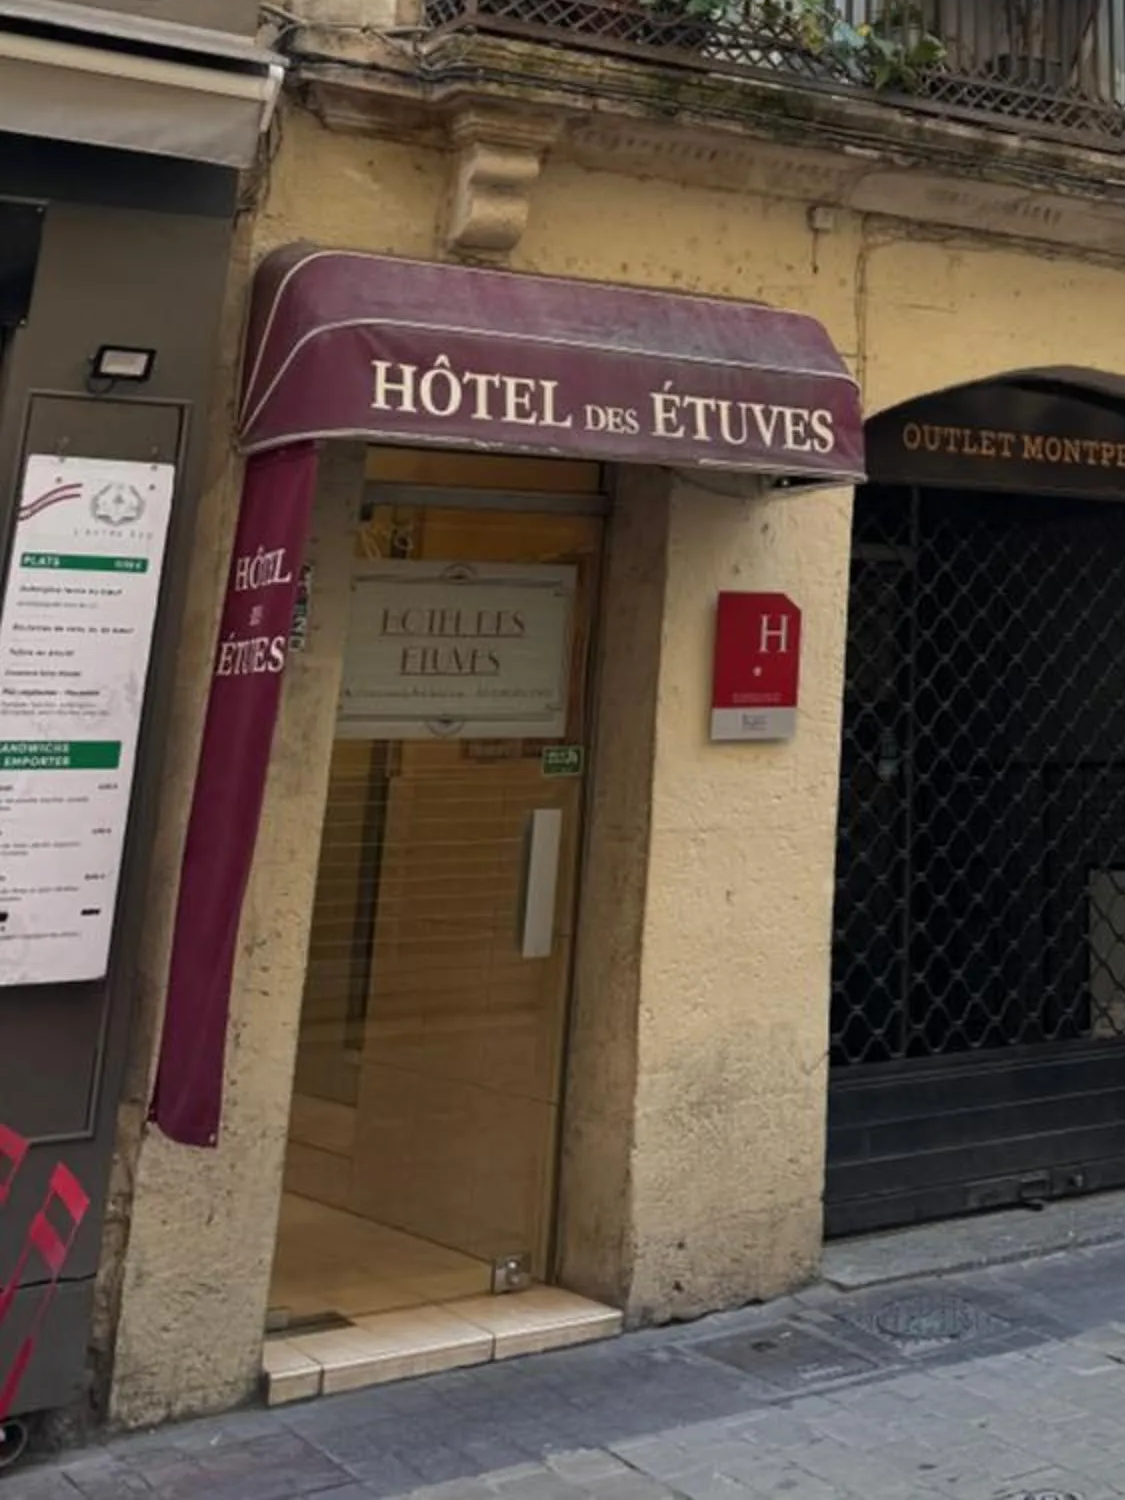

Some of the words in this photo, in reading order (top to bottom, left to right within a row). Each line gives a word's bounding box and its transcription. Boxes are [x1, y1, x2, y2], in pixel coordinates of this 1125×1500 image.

[370, 353, 574, 430] HÔTEL
[583, 402, 641, 435] DES
[650, 379, 836, 454] ÉTUVES
[902, 422, 1018, 458] OUTLET
[759, 613, 791, 653] H
